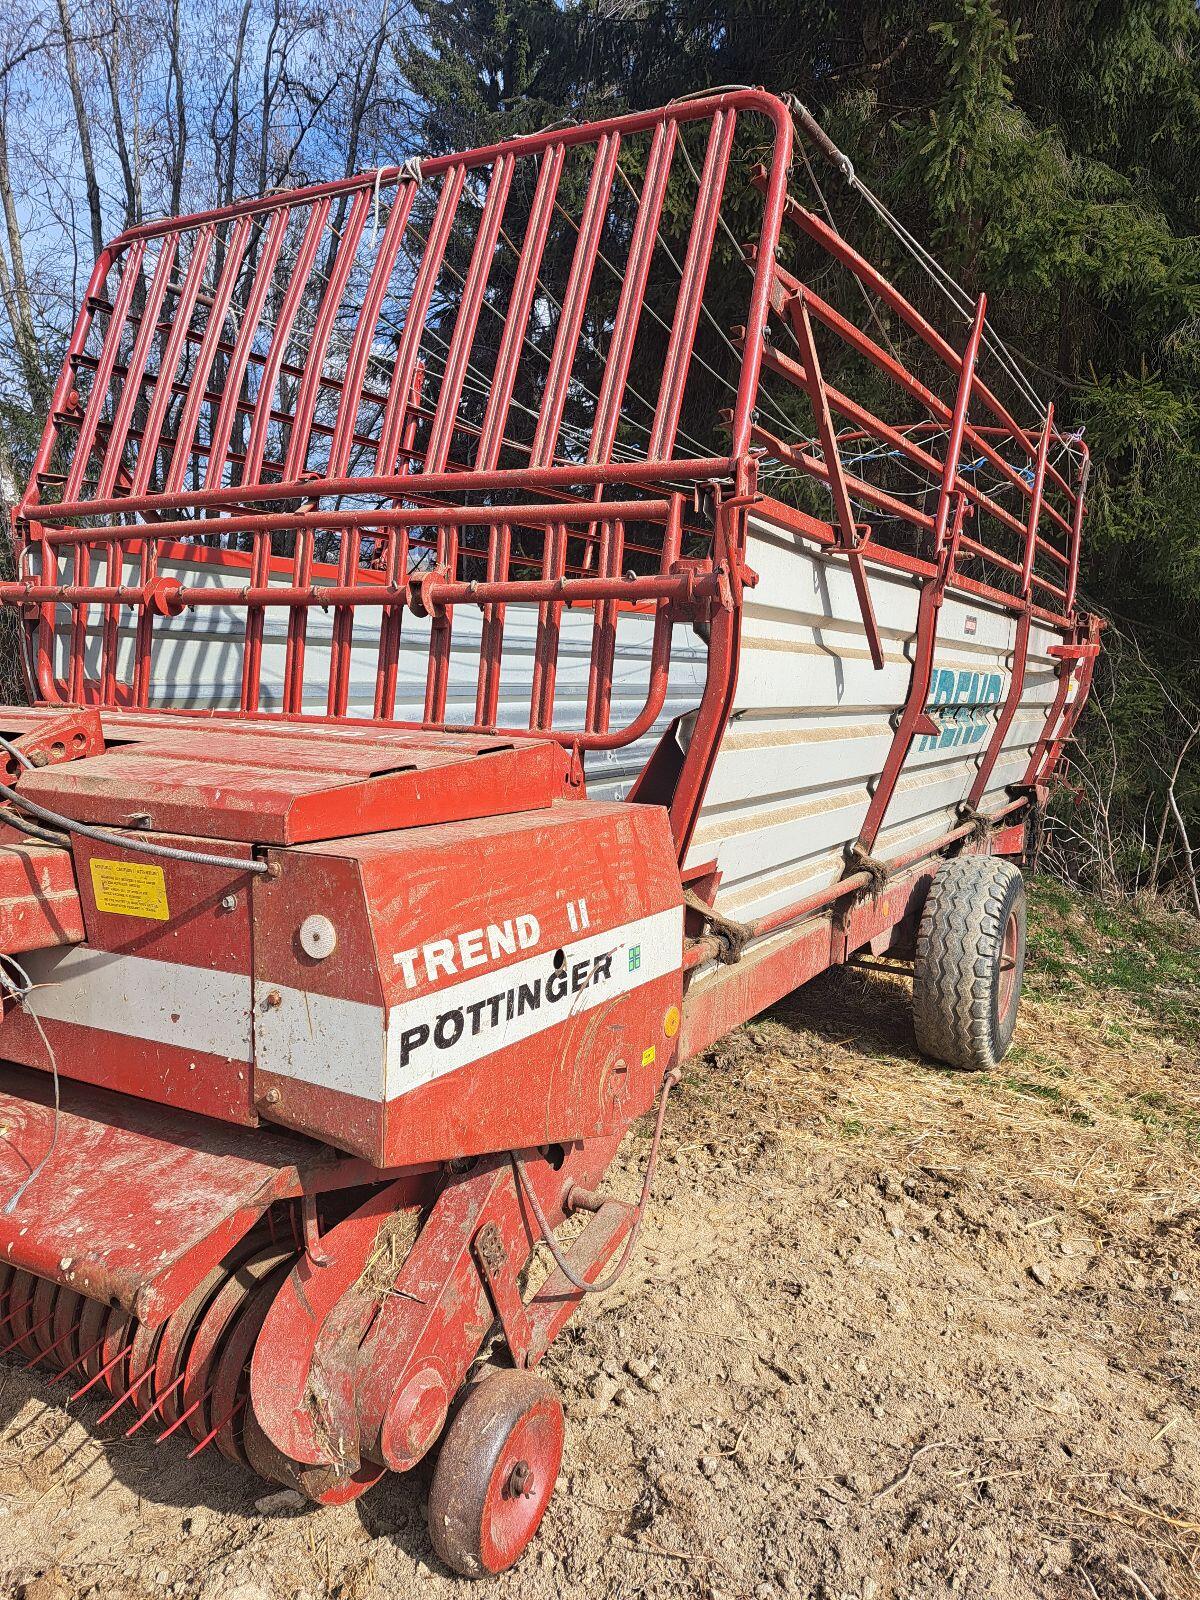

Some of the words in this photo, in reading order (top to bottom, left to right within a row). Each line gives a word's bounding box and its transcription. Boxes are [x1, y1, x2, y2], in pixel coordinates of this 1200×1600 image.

[919, 668, 1002, 752] REND
[393, 914, 541, 990] TREND
[566, 899, 589, 932] II
[400, 952, 613, 1067] PÖTTINGER
